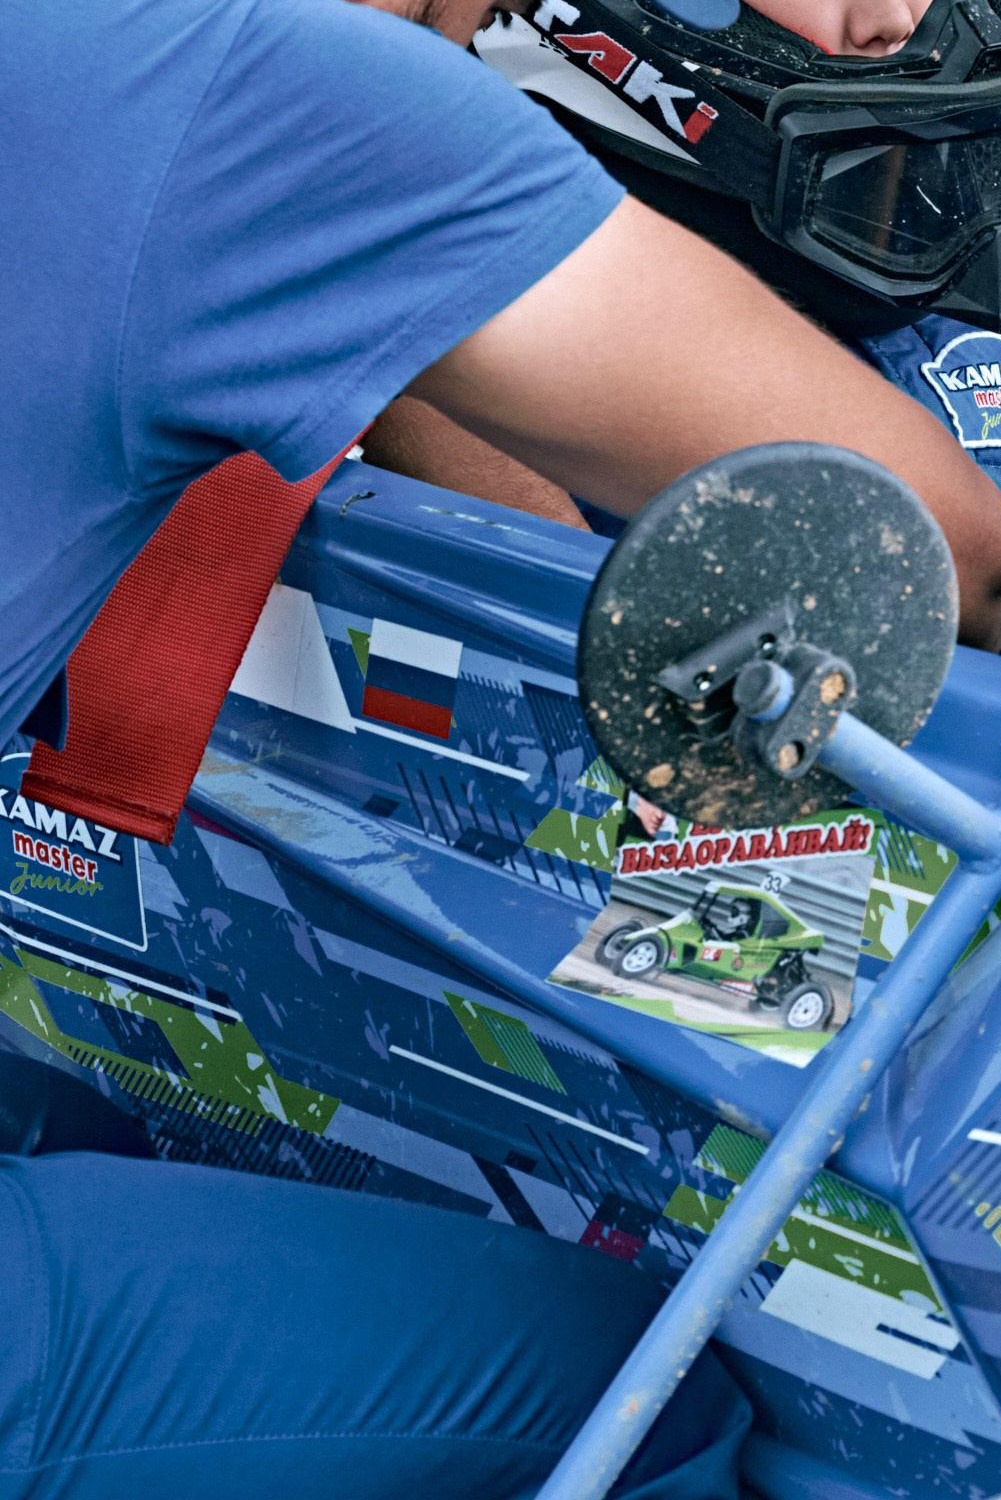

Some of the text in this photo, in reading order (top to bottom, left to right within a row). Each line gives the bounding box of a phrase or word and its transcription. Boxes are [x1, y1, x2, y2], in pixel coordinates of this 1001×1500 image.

[12, 829, 98, 884] master
[620, 819, 871, 875] ВЫЗДОРАВЛИВАЙ!
[10, 862, 104, 896] Junior
[764, 874, 782, 895] 33
